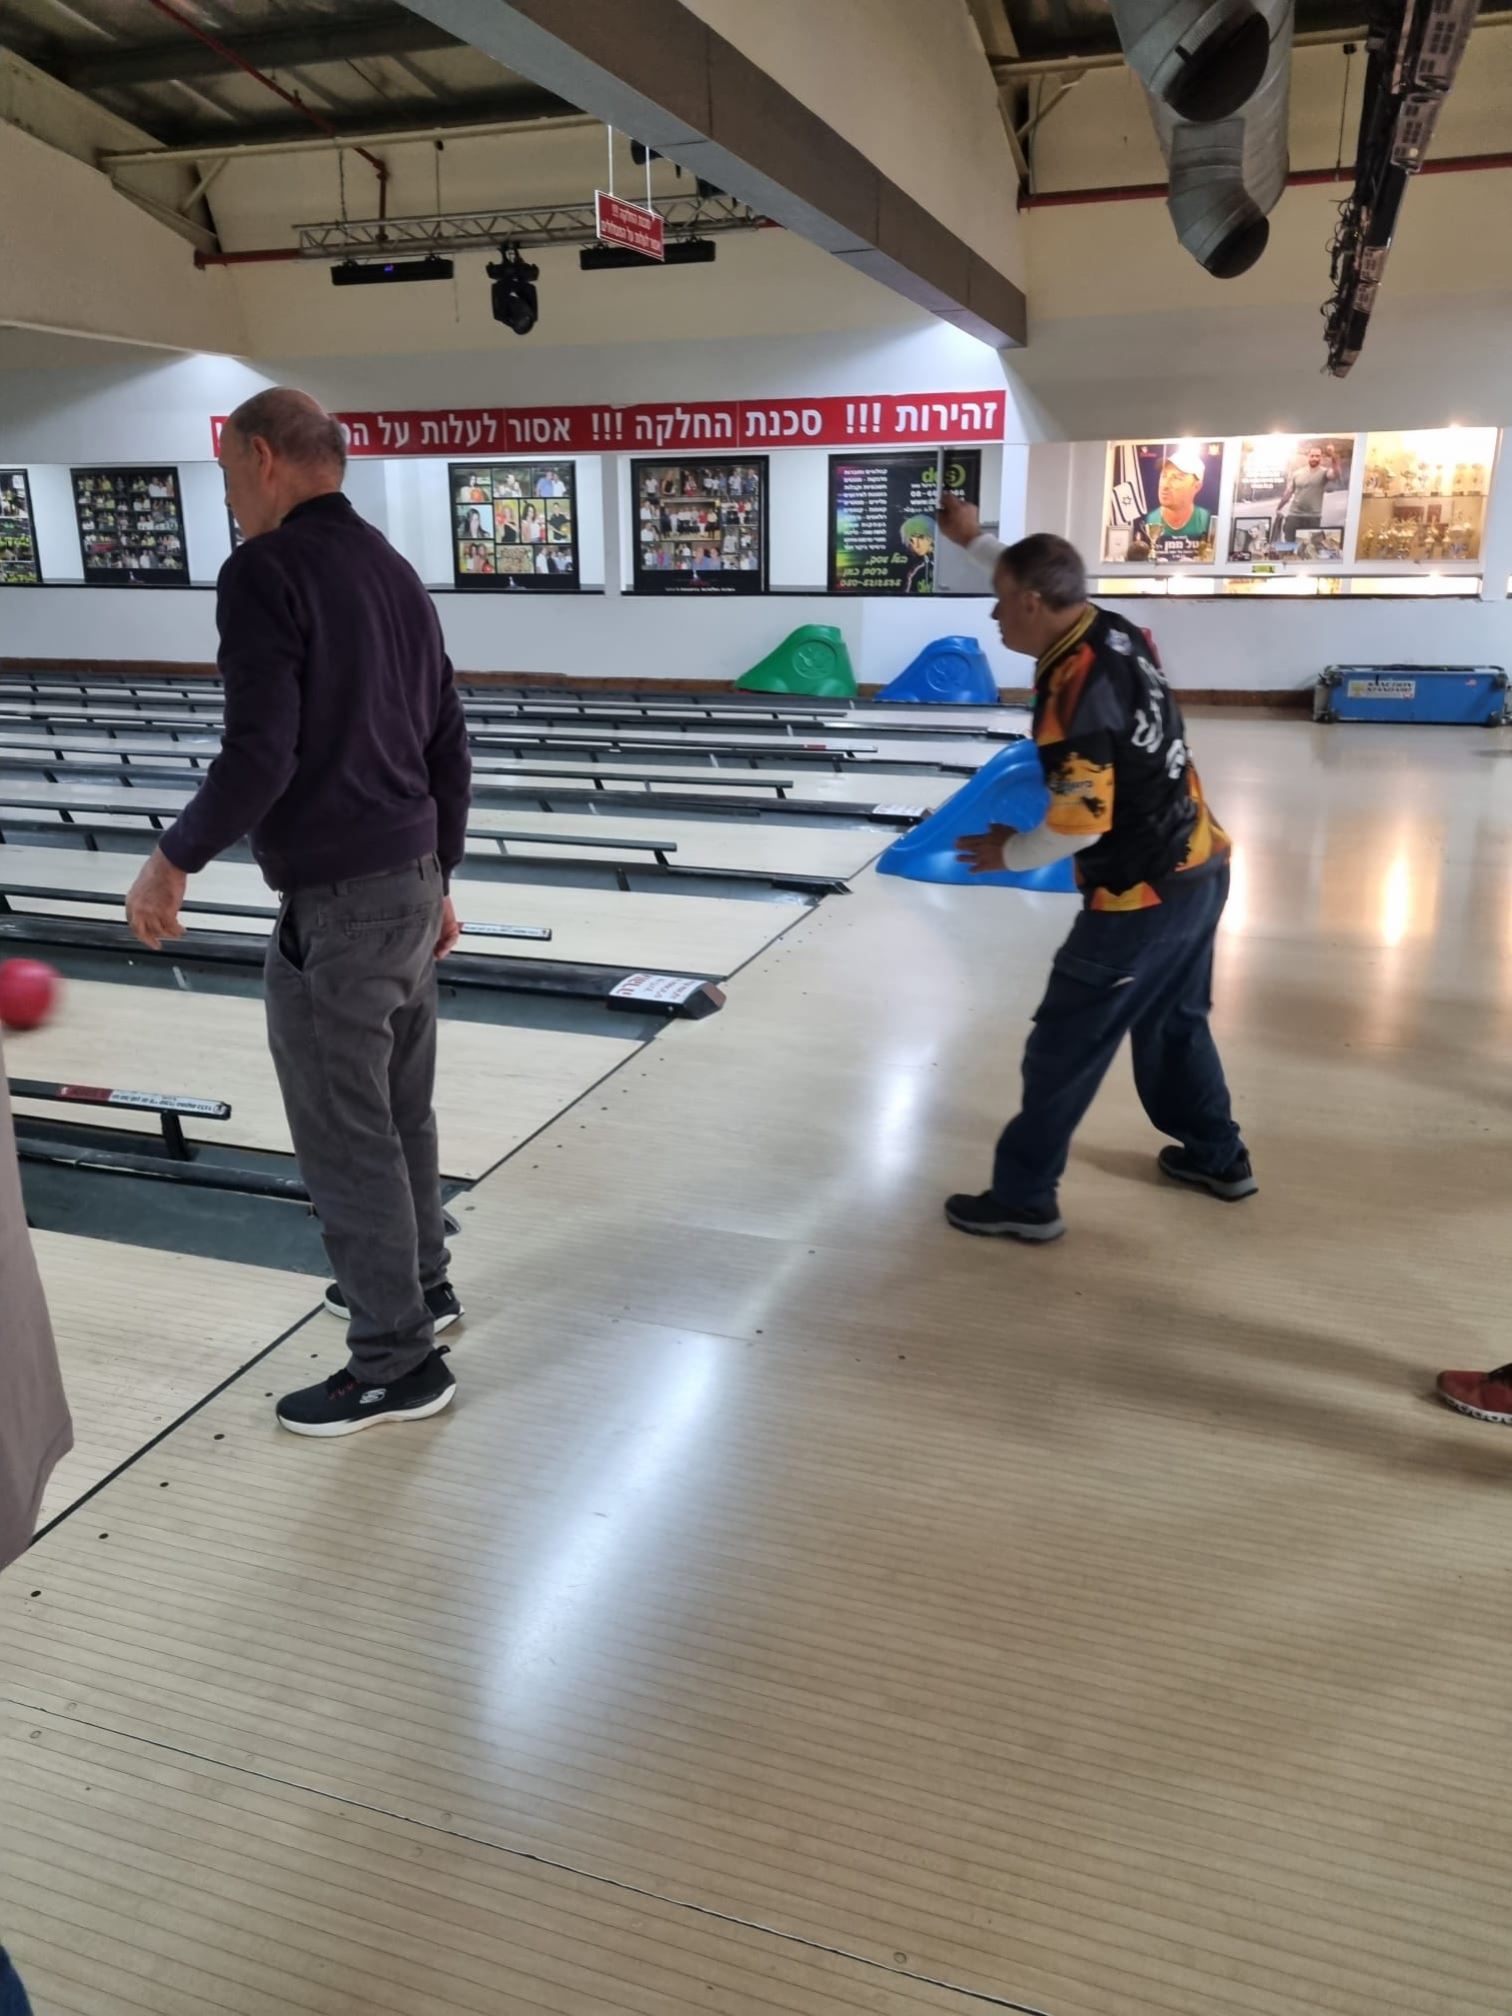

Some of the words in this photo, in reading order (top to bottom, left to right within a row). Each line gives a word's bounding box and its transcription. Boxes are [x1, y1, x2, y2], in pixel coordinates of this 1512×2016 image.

[377, 415, 409, 448] על
[421, 413, 496, 447] לעלות
[508, 417, 570, 443] אסור
[592, 412, 622, 441] !!!
[635, 406, 732, 446] החלקה
[745, 409, 822, 437] סכנת
[846, 403, 881, 434] !!!
[895, 402, 997, 432] זהירות
